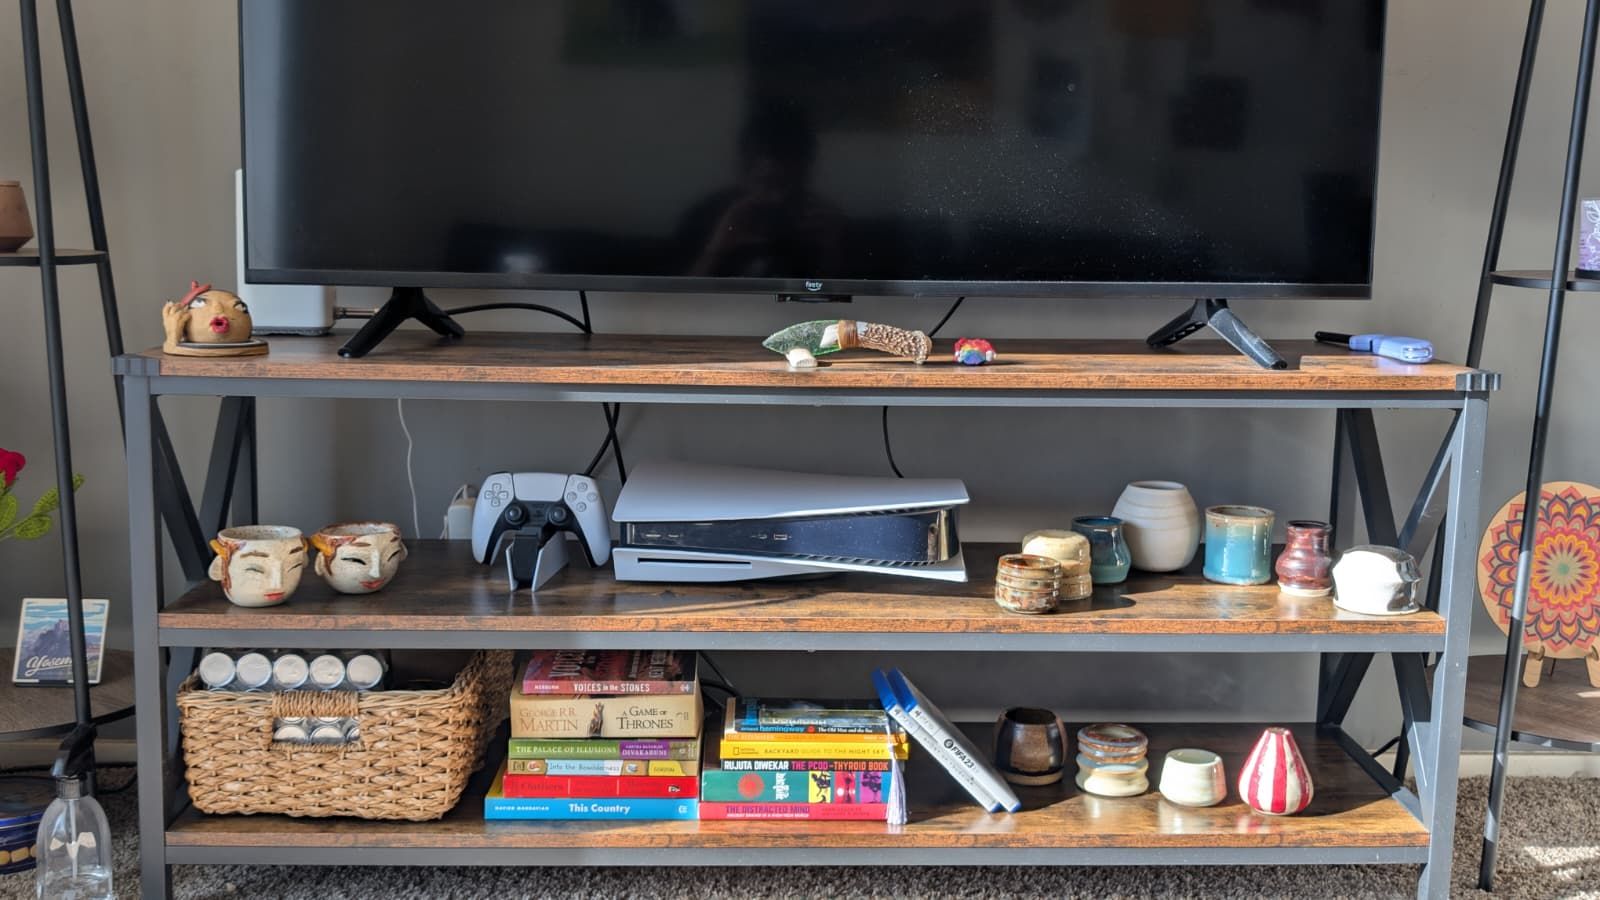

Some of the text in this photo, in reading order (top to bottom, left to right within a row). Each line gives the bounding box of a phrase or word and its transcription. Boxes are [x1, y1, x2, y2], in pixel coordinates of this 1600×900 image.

[573, 683, 601, 692] VOICES
[620, 683, 650, 692] STONES
[629, 706, 658, 717] GAME
[519, 718, 578, 732] MARTIN
[615, 717, 674, 730] THRONES
[724, 760, 753, 770] RUJUTA
[754, 760, 790, 770] DIWEKAR
[791, 761, 807, 770] THE
[868, 761, 889, 770] BOOK
[568, 803, 631, 815] This Country
[726, 805, 810, 813] THE DISTRACTED MIND
